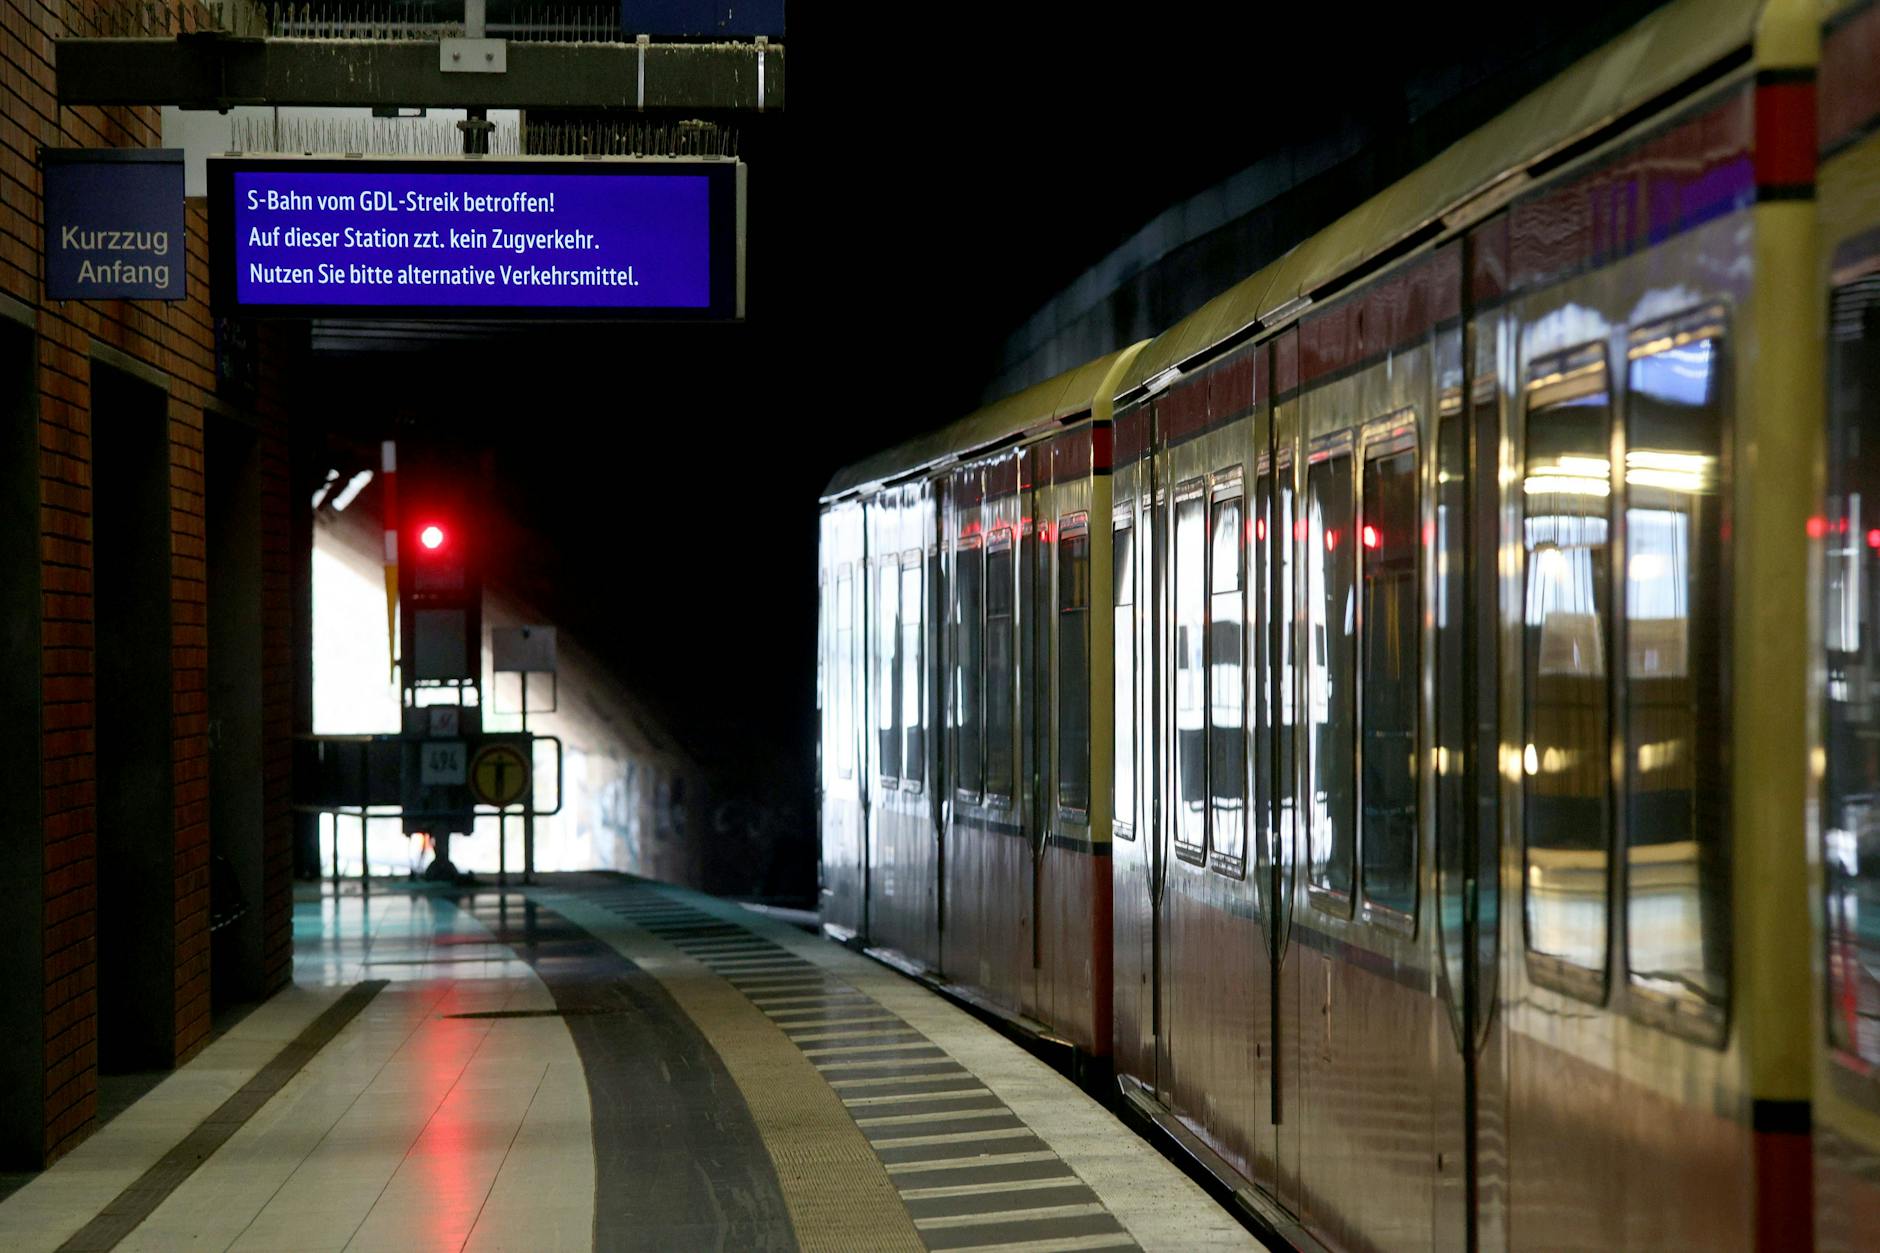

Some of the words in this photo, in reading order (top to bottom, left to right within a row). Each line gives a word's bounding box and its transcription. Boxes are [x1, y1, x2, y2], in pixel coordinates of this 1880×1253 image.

[247, 189, 313, 211] S-Bahn
[317, 195, 355, 211] vom
[359, 190, 460, 212] GDL-Streik
[463, 191, 555, 213] betroffen!
[61, 226, 169, 256] Kurzzug
[248, 225, 281, 247] Auf
[284, 226, 340, 248] dieser
[343, 226, 409, 248] Station
[413, 230, 445, 249] zzt.
[449, 227, 487, 249] kein
[491, 228, 600, 254] Zugverkehr.
[77, 260, 170, 289] Anfang
[250, 262, 314, 284] Nutzen
[318, 263, 346, 284] Sie
[349, 263, 394, 285] bitte
[397, 263, 496, 286] alternative
[499, 264, 639, 286] Verkehrsmittel.
